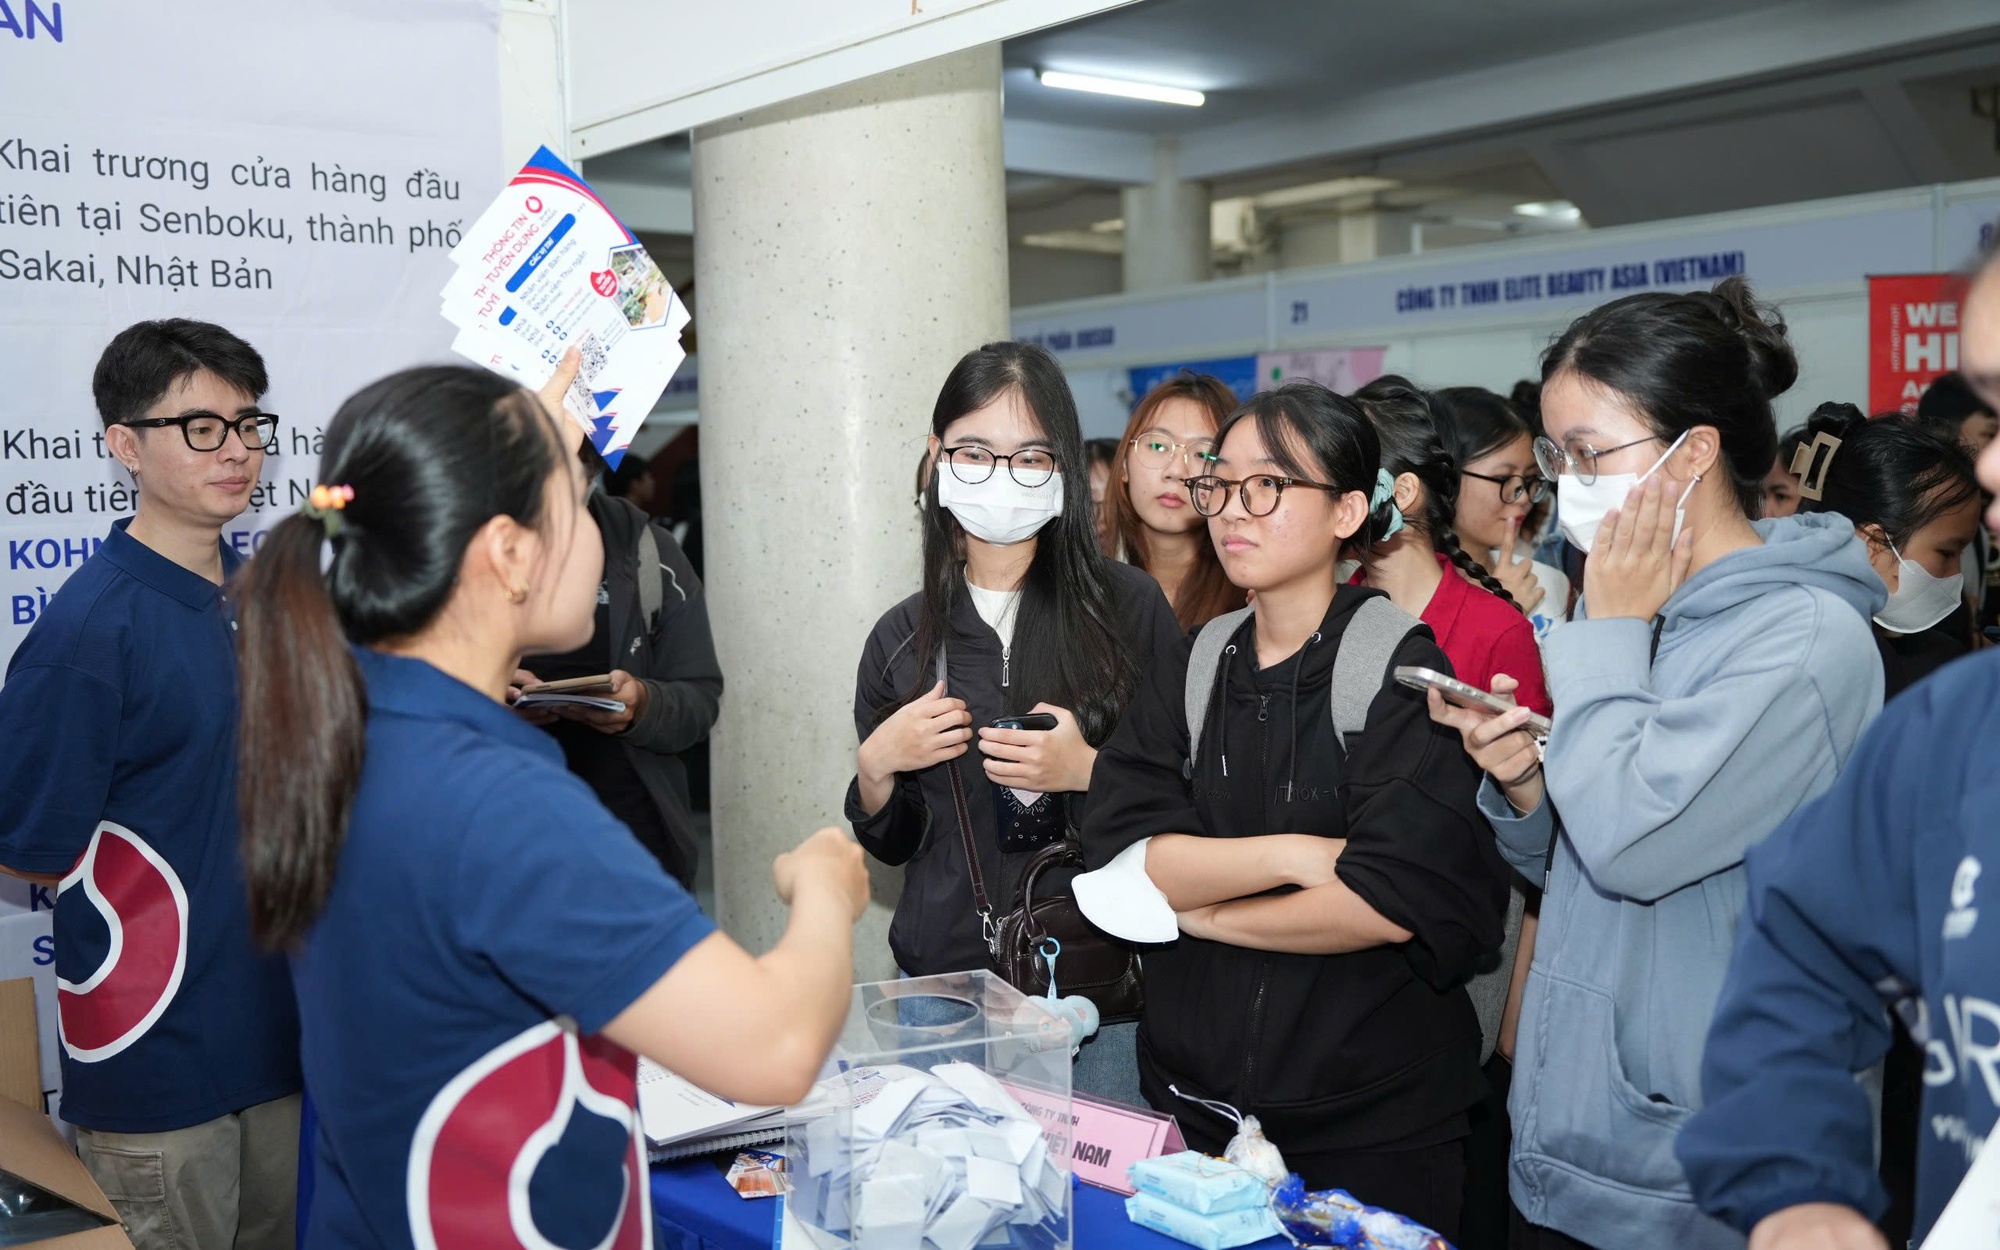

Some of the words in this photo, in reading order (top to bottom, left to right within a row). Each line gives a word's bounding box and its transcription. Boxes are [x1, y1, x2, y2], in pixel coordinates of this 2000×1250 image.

[0, 139, 70, 173] Khai
[93, 149, 209, 190] trương
[231, 156, 291, 188] cửa
[312, 162, 386, 202] hàng
[406, 168, 459, 200] đầu
[0, 195, 60, 227] tiên
[77, 202, 121, 236] tại
[140, 204, 292, 244] Senboku,
[306, 213, 394, 245] thành
[409, 220, 462, 253] phố
[510, 213, 529, 231] TIN
[0, 250, 104, 288] Sakai,
[117, 255, 198, 292] Nhật
[211, 257, 272, 289] Bản
[1440, 284, 1455, 307] TY
[1504, 275, 1541, 302] ELITE
[1548, 267, 1605, 297] BEAUTY
[1611, 263, 1648, 288] ASIA
[1906, 302, 1958, 327] WE
[1905, 333, 1958, 371] HI
[4, 430, 80, 460] Khai
[292, 427, 325, 455] hà
[6, 481, 73, 514] đầu
[1044, 1108, 1056, 1120] TY
[1072, 1141, 1112, 1168] NAM
